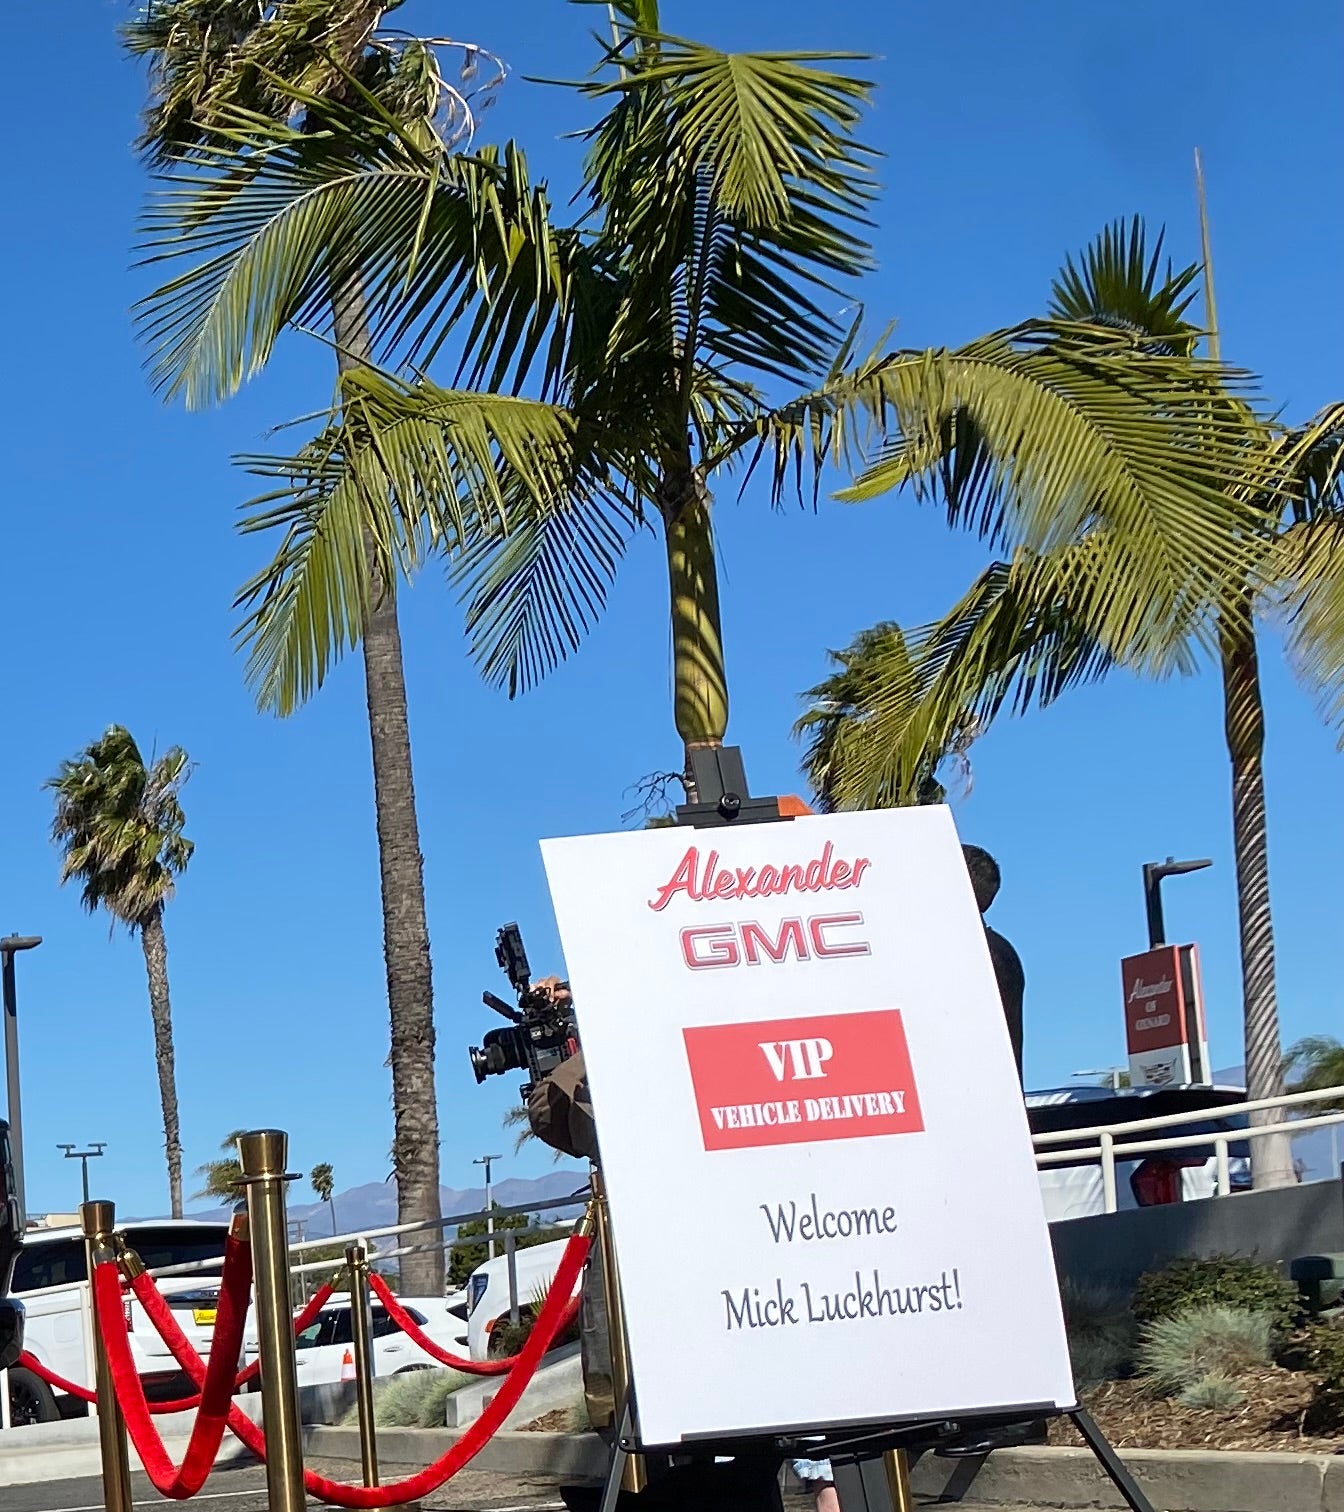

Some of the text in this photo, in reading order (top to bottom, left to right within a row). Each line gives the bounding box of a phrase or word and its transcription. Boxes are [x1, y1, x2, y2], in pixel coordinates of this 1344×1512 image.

[648, 840, 871, 911] Alexander
[679, 911, 872, 971] GMC
[758, 1037, 834, 1082] VIP
[710, 1090, 906, 1130] VEHICLE DELIVERY
[759, 1193, 898, 1243] Welcome
[721, 1268, 963, 1330] Mick Luckhurst!
